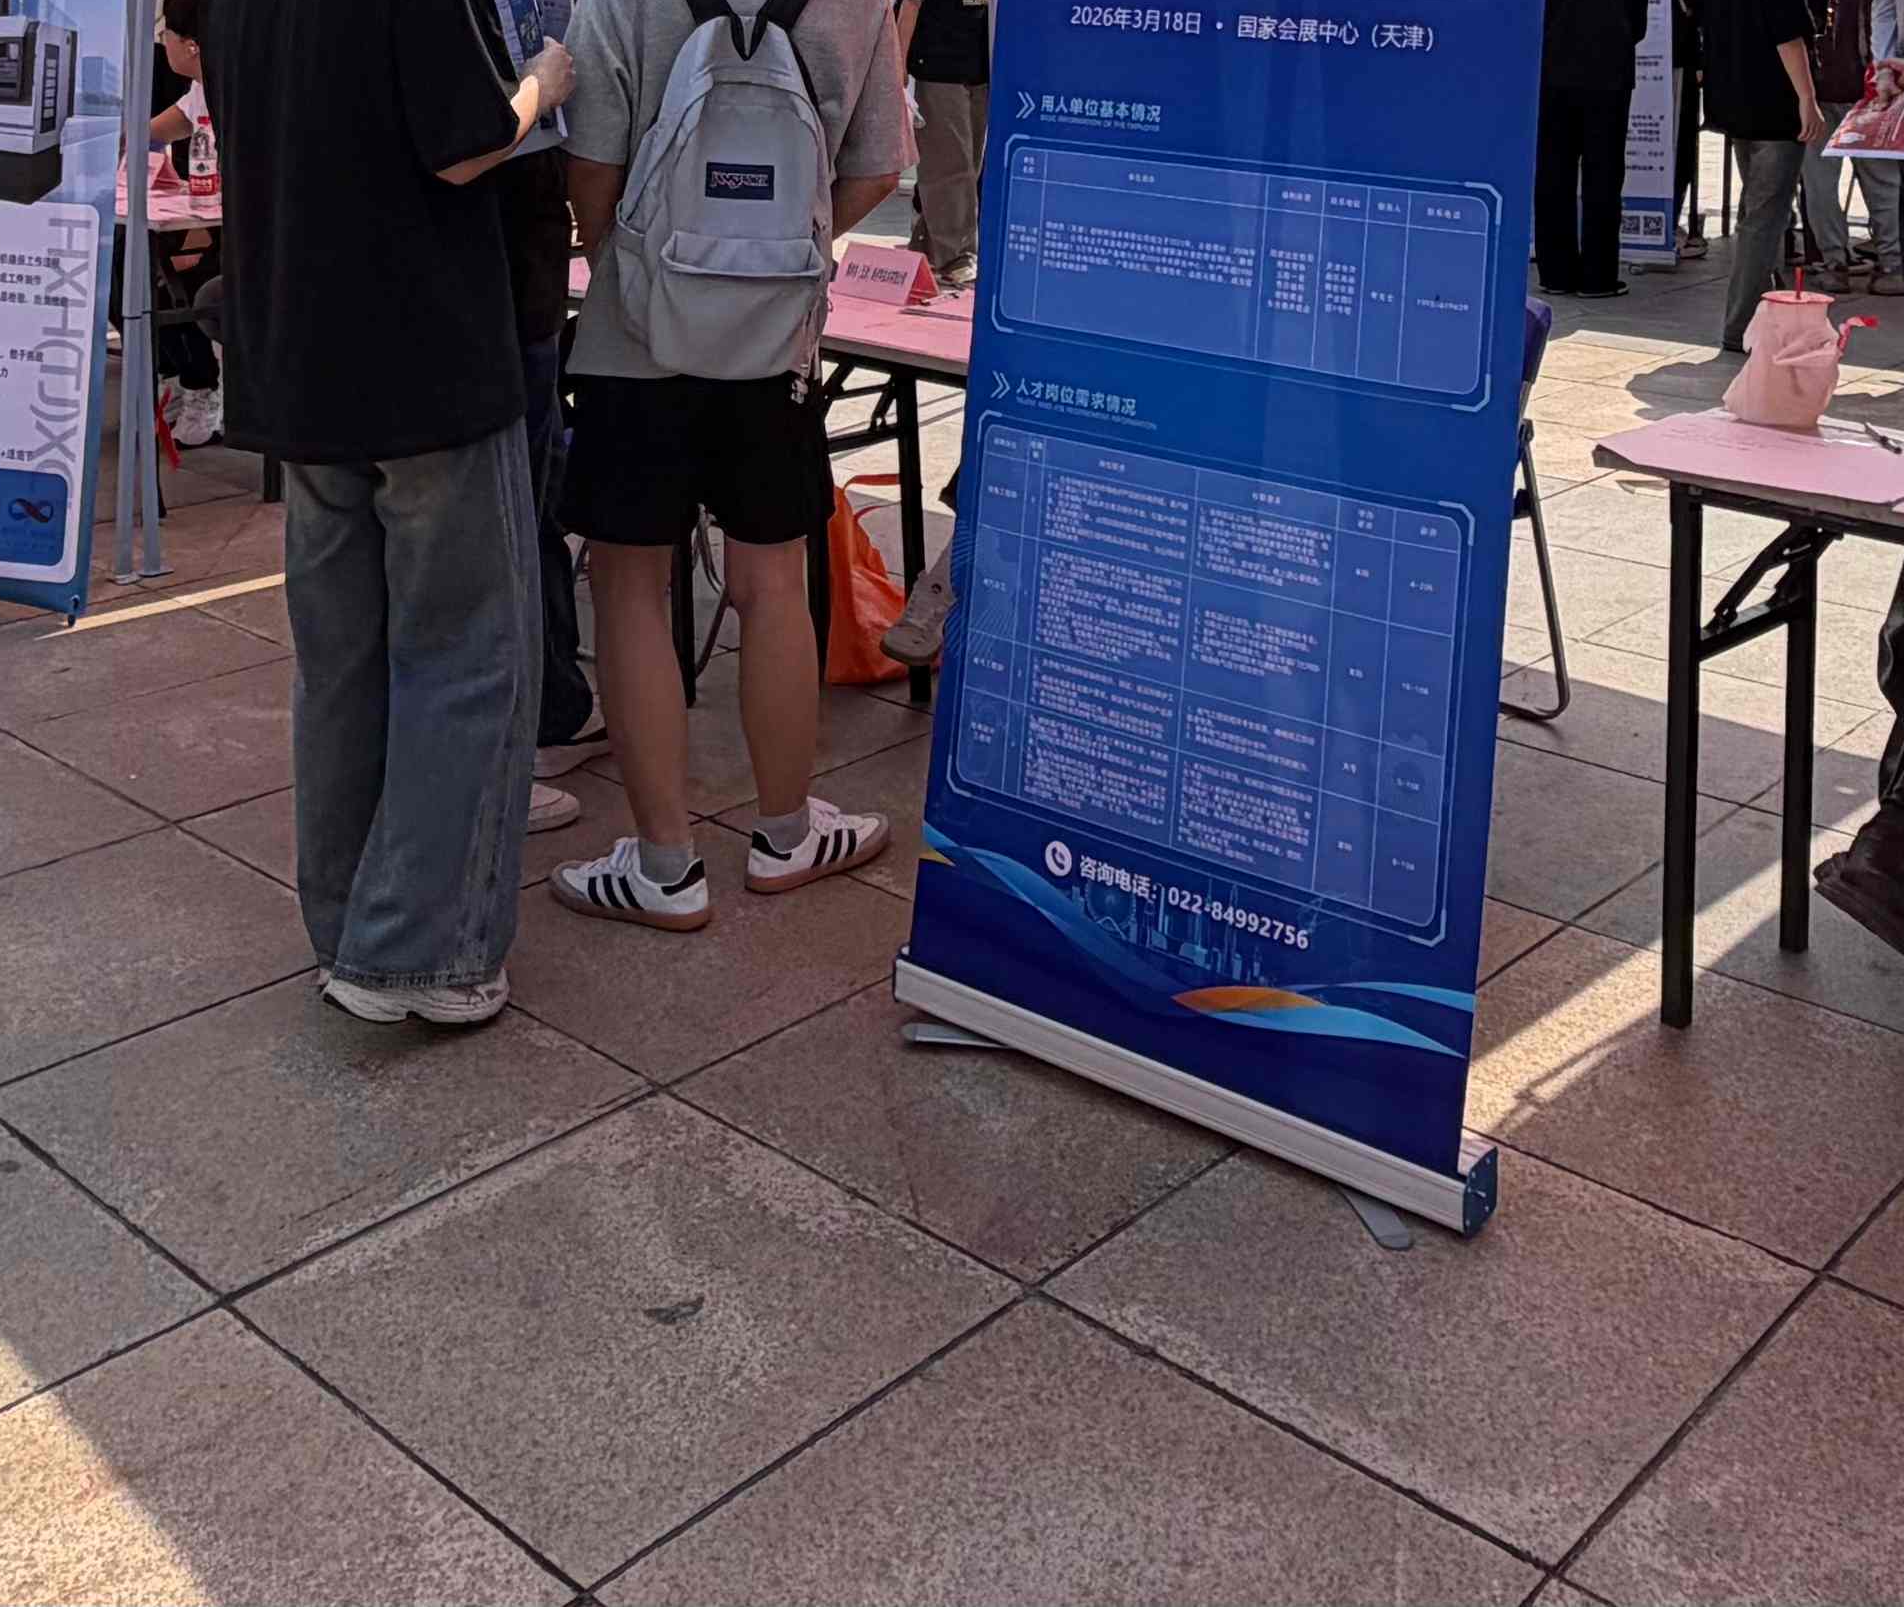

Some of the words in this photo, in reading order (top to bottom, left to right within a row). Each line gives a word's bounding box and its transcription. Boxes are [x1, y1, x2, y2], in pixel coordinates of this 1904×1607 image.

[1070, 5, 1203, 36] 2026年3月18日
[1039, 93, 1162, 123] 用人单位基本情况
[1015, 378, 1137, 416] 人才岗位需求情况
